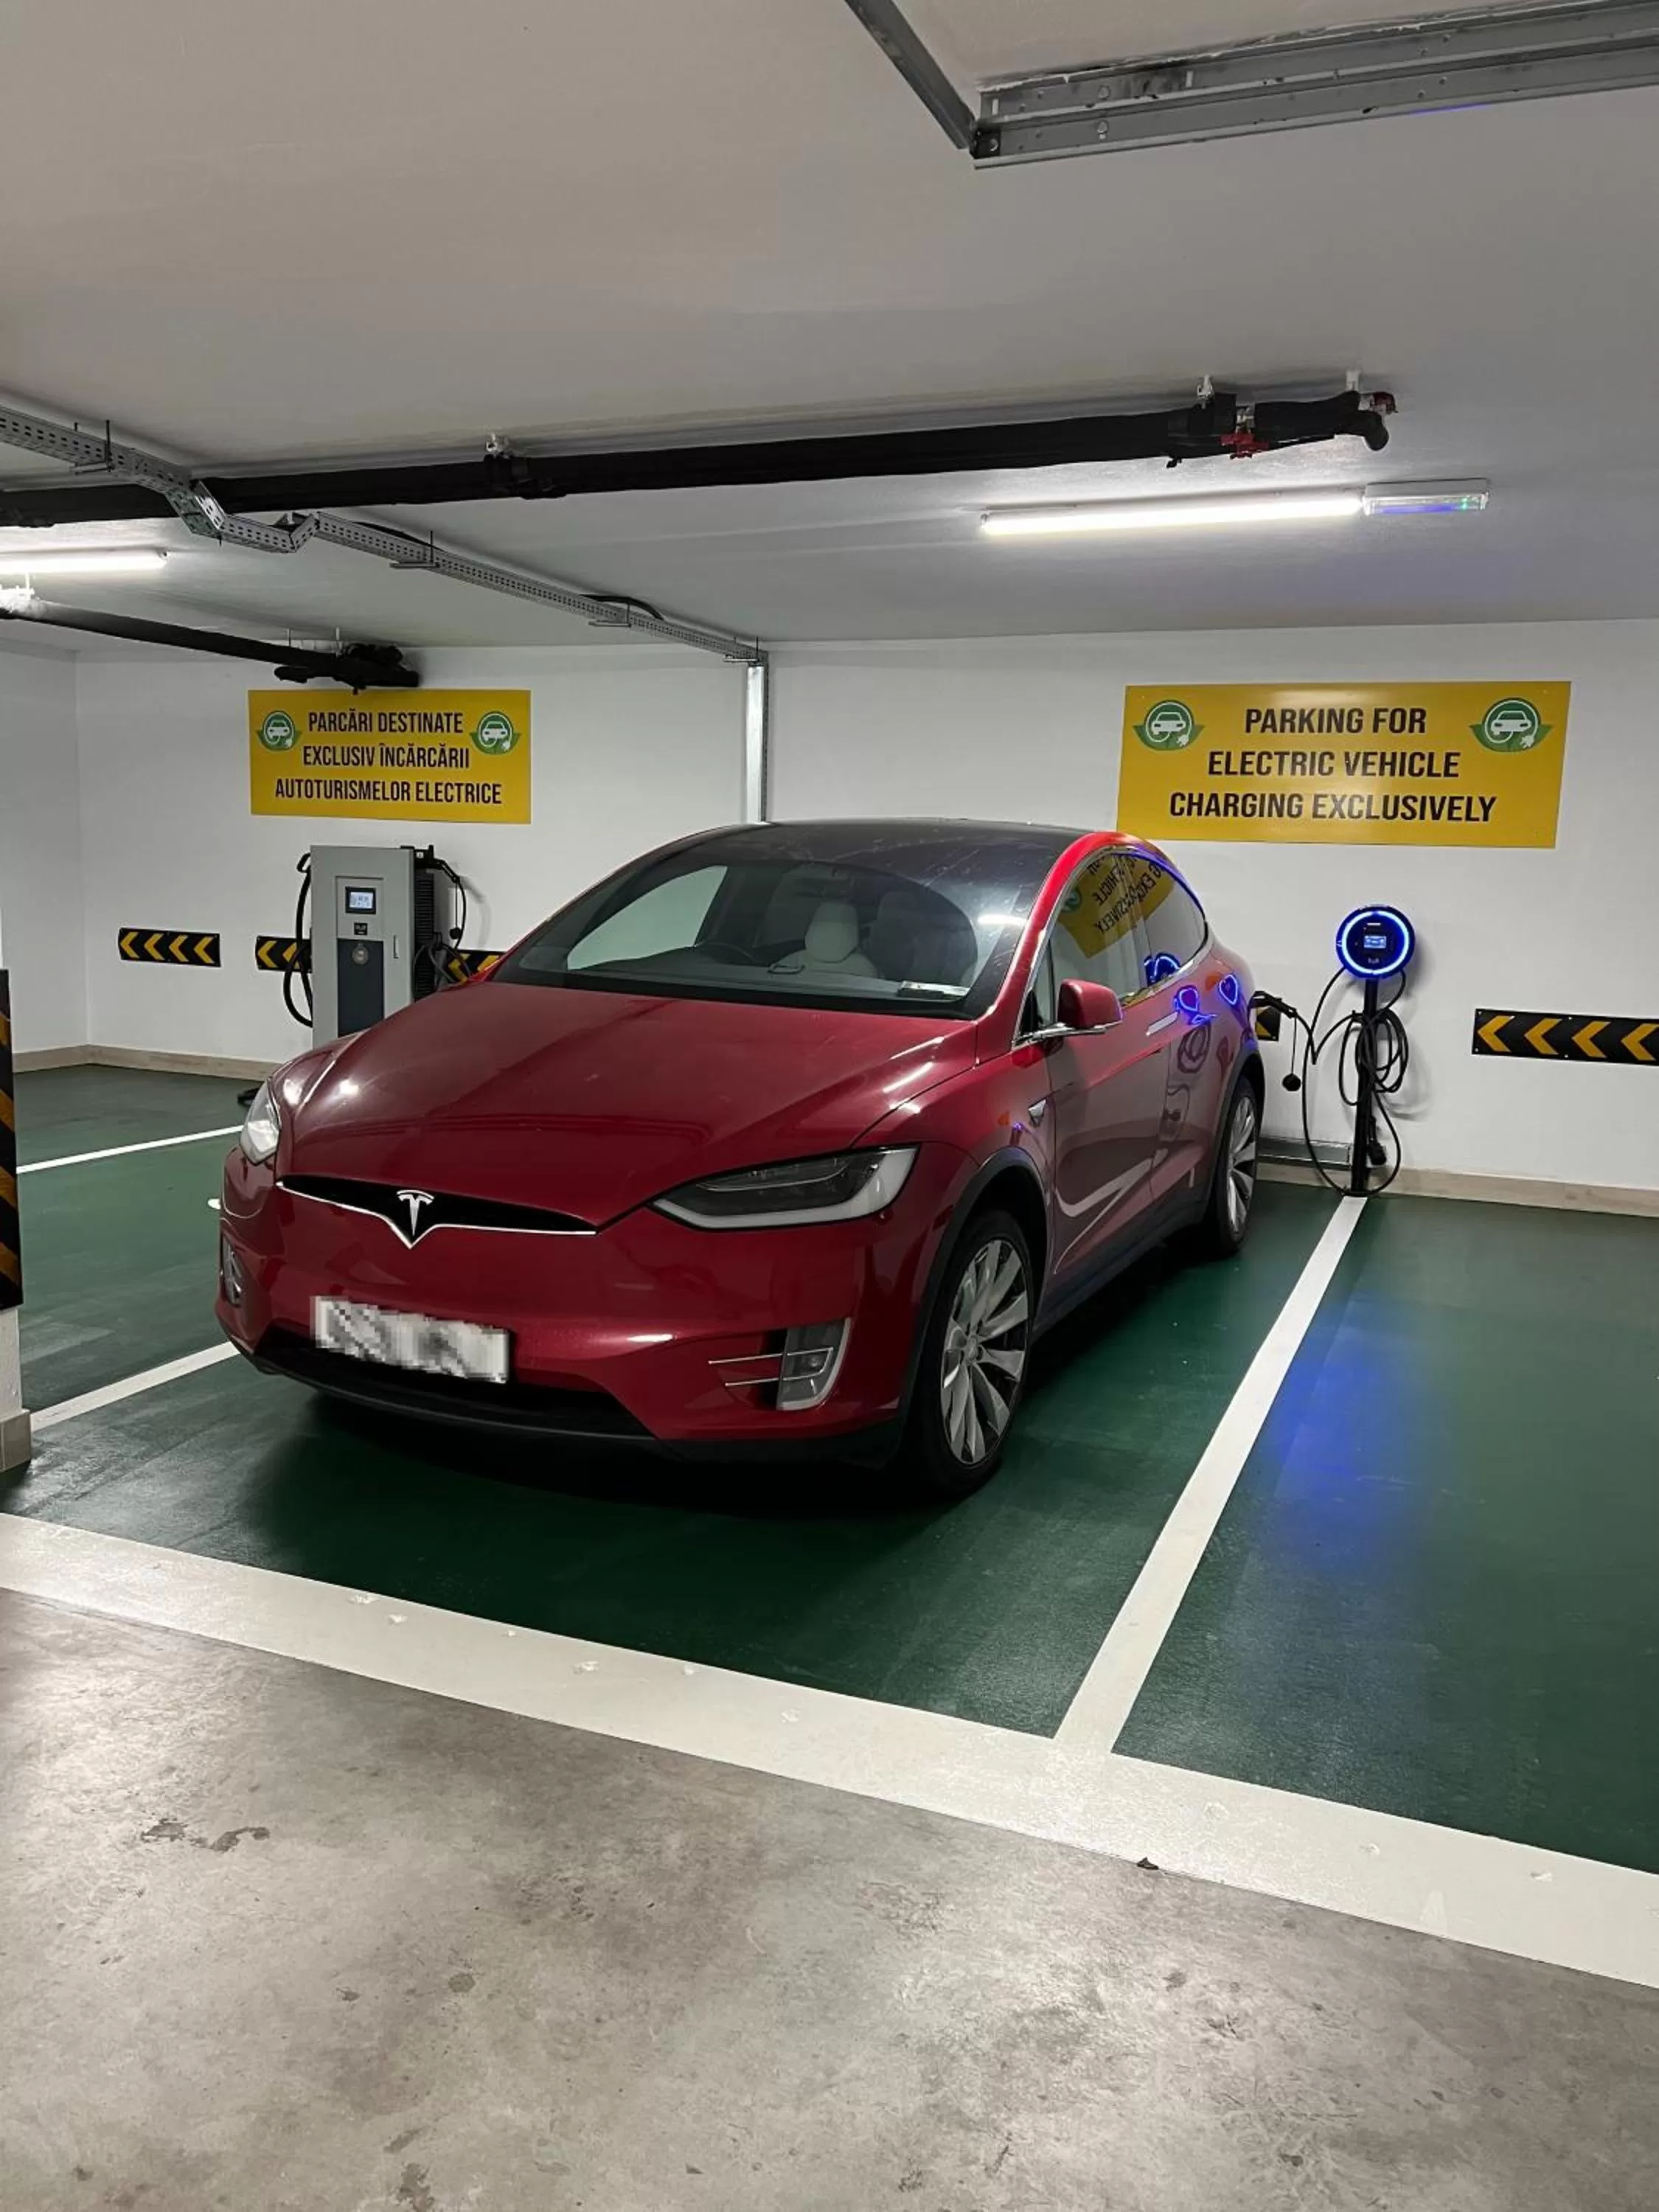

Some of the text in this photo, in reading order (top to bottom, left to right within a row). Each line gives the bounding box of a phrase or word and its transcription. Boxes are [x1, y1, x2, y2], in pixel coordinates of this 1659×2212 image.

[308, 708, 464, 733] PARCĂRI DESTINATE
[1245, 708, 1427, 734] PARKING FOR
[303, 742, 470, 768] EXCLUSIV ÎNCĂRCĂRII
[1208, 751, 1461, 778] ELECTRIC VEHICLE
[275, 779, 502, 804] AUTOTURISMELOR ELECTRICE
[1169, 793, 1496, 822] CHARGING EXCLUSIVELY
